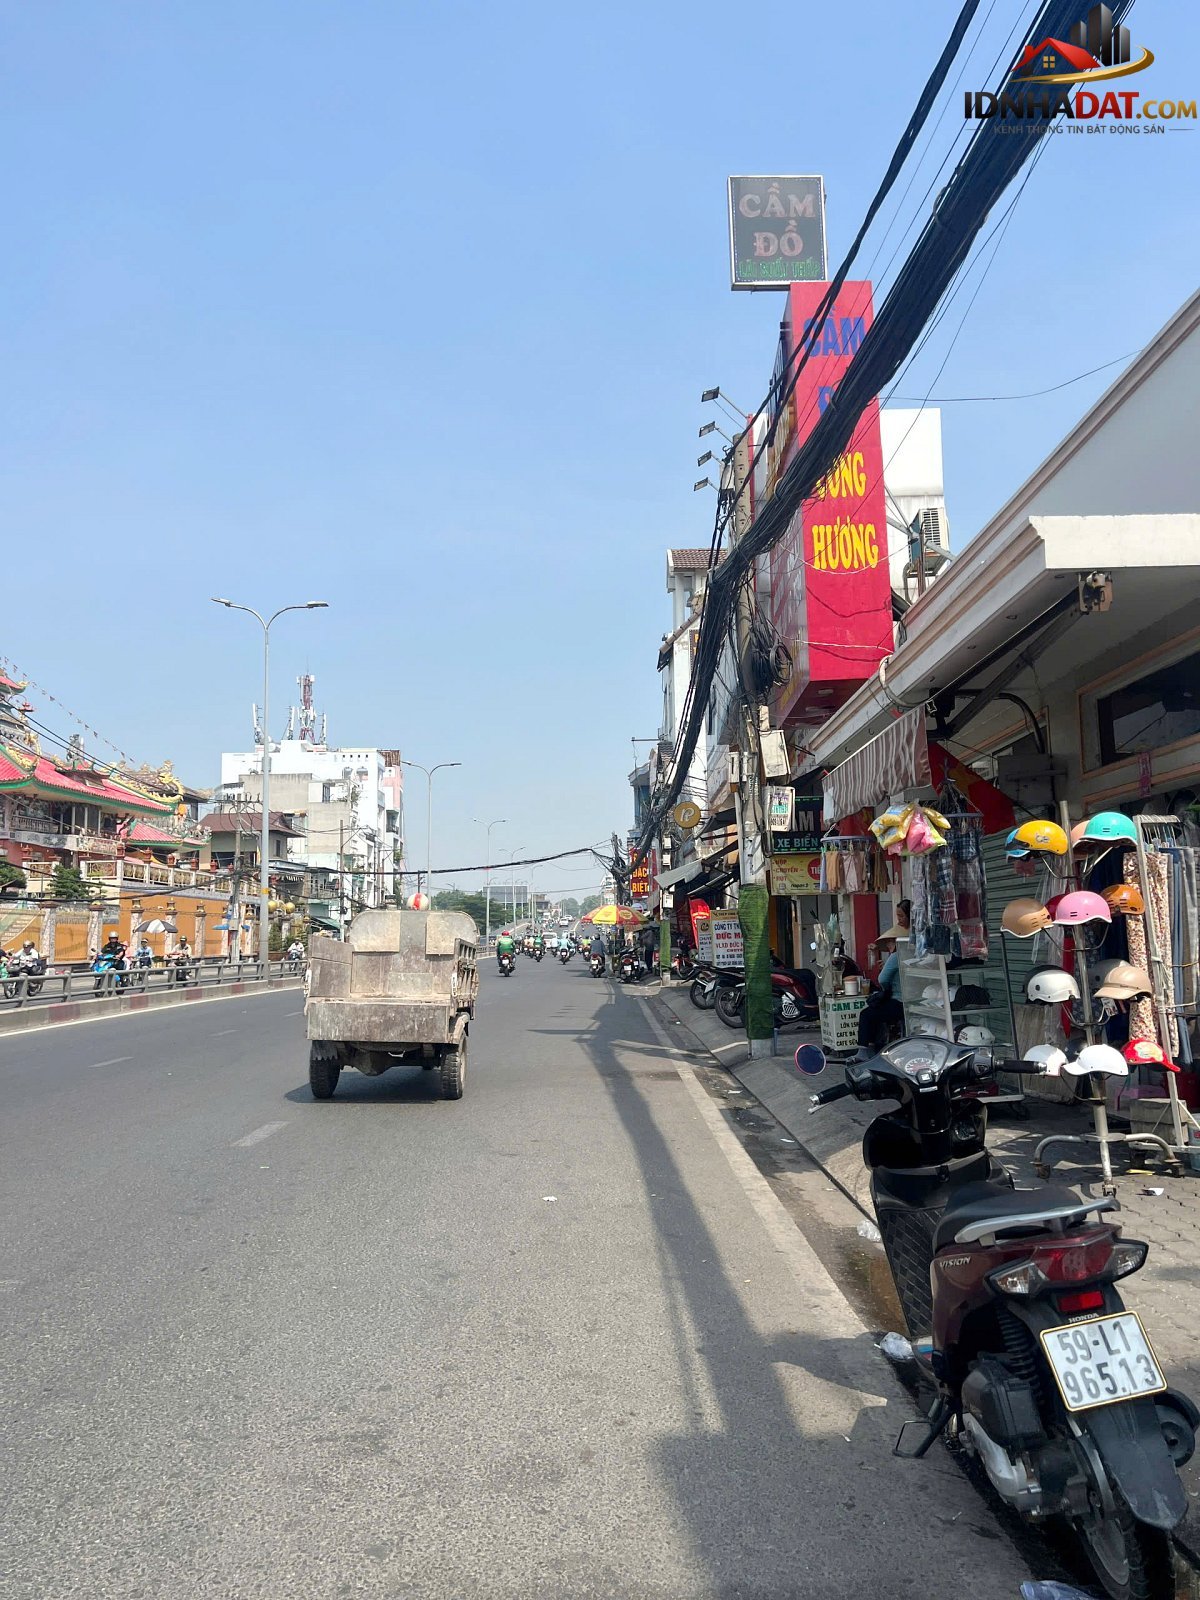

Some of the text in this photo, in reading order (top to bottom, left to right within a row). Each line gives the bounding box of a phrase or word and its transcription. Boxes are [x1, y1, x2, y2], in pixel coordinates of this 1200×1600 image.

[739, 182, 816, 218] CẦM
[753, 219, 804, 257] ĐỒ
[777, 838, 790, 848] XE
[632, 881, 648, 895] BIỆT
[831, 1002, 851, 1011] CAM
[939, 1256, 971, 1268] VISION
[1068, 1312, 1100, 1324] HONDA
[1056, 1320, 1132, 1365] 59-L1
[1062, 1353, 1158, 1404] 965.13
